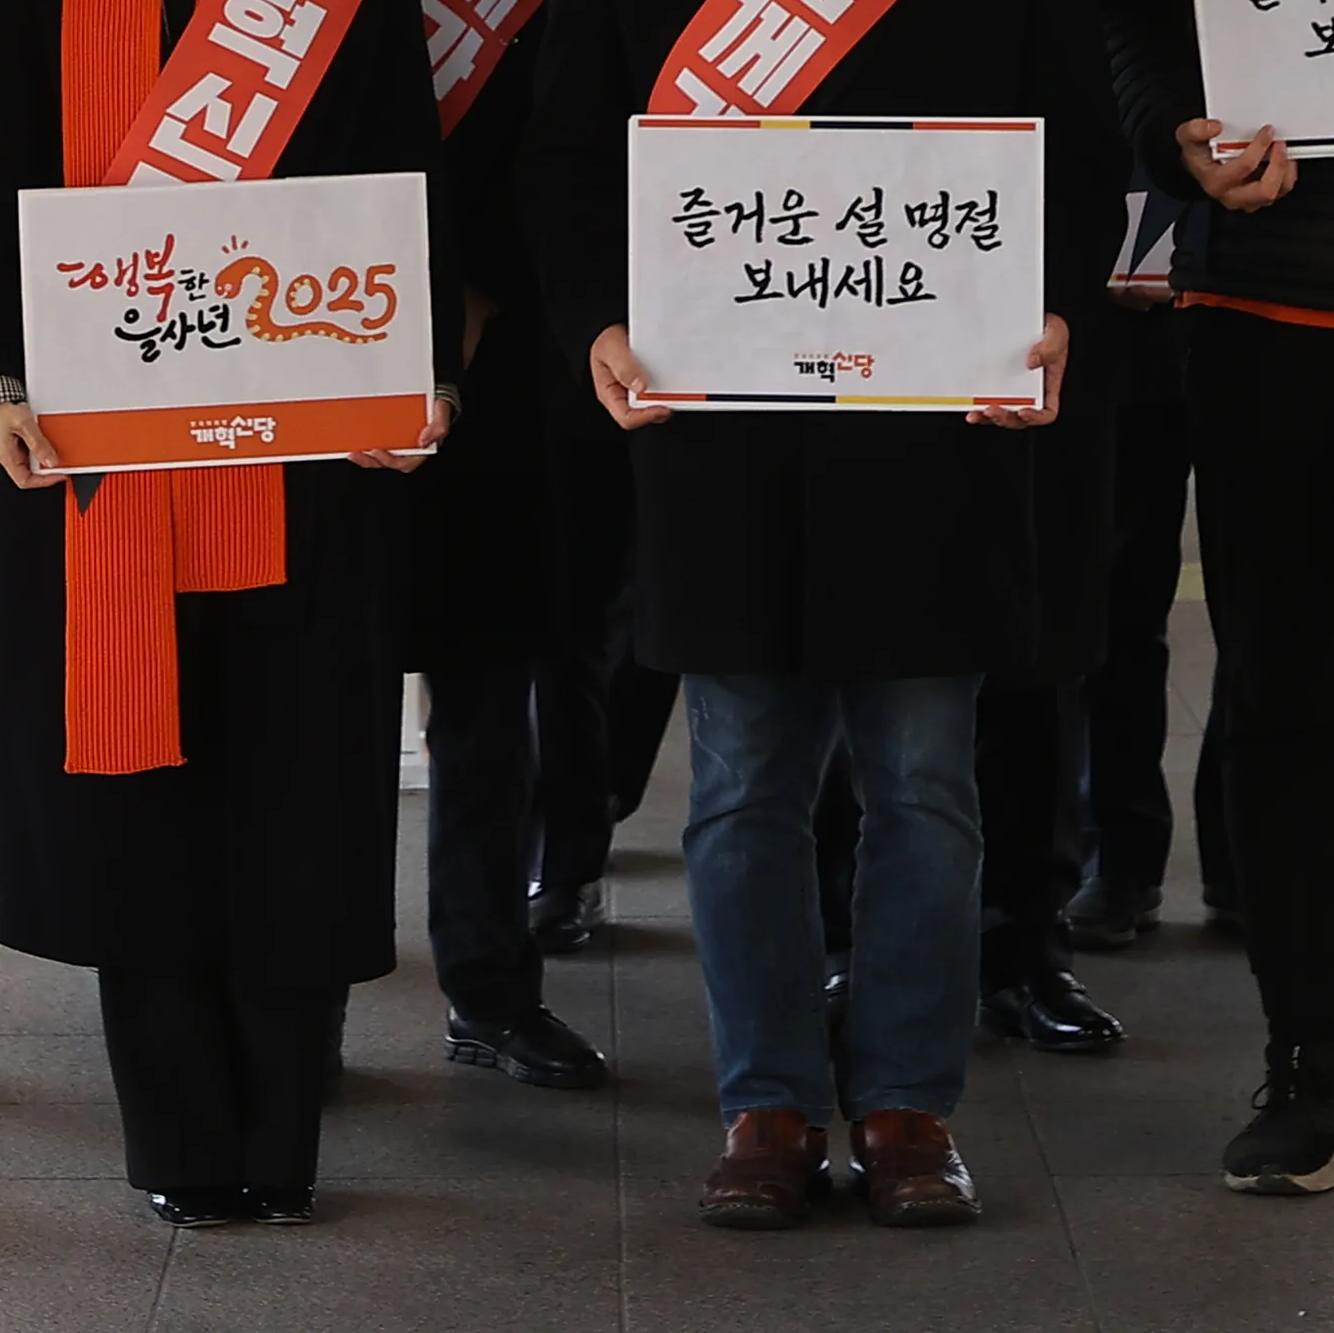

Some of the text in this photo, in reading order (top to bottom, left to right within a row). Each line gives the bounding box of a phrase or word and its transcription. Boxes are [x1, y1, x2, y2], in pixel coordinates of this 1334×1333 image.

[672, 186, 1003, 251] 즐거운 설 명절
[56, 232, 212, 322] 행복한
[214, 256, 398, 344] 2025
[734, 254, 937, 309] 보내세요
[114, 303, 242, 363] 을사년
[793, 351, 875, 383] 개혁신당
[190, 415, 277, 450] 개혁신당
